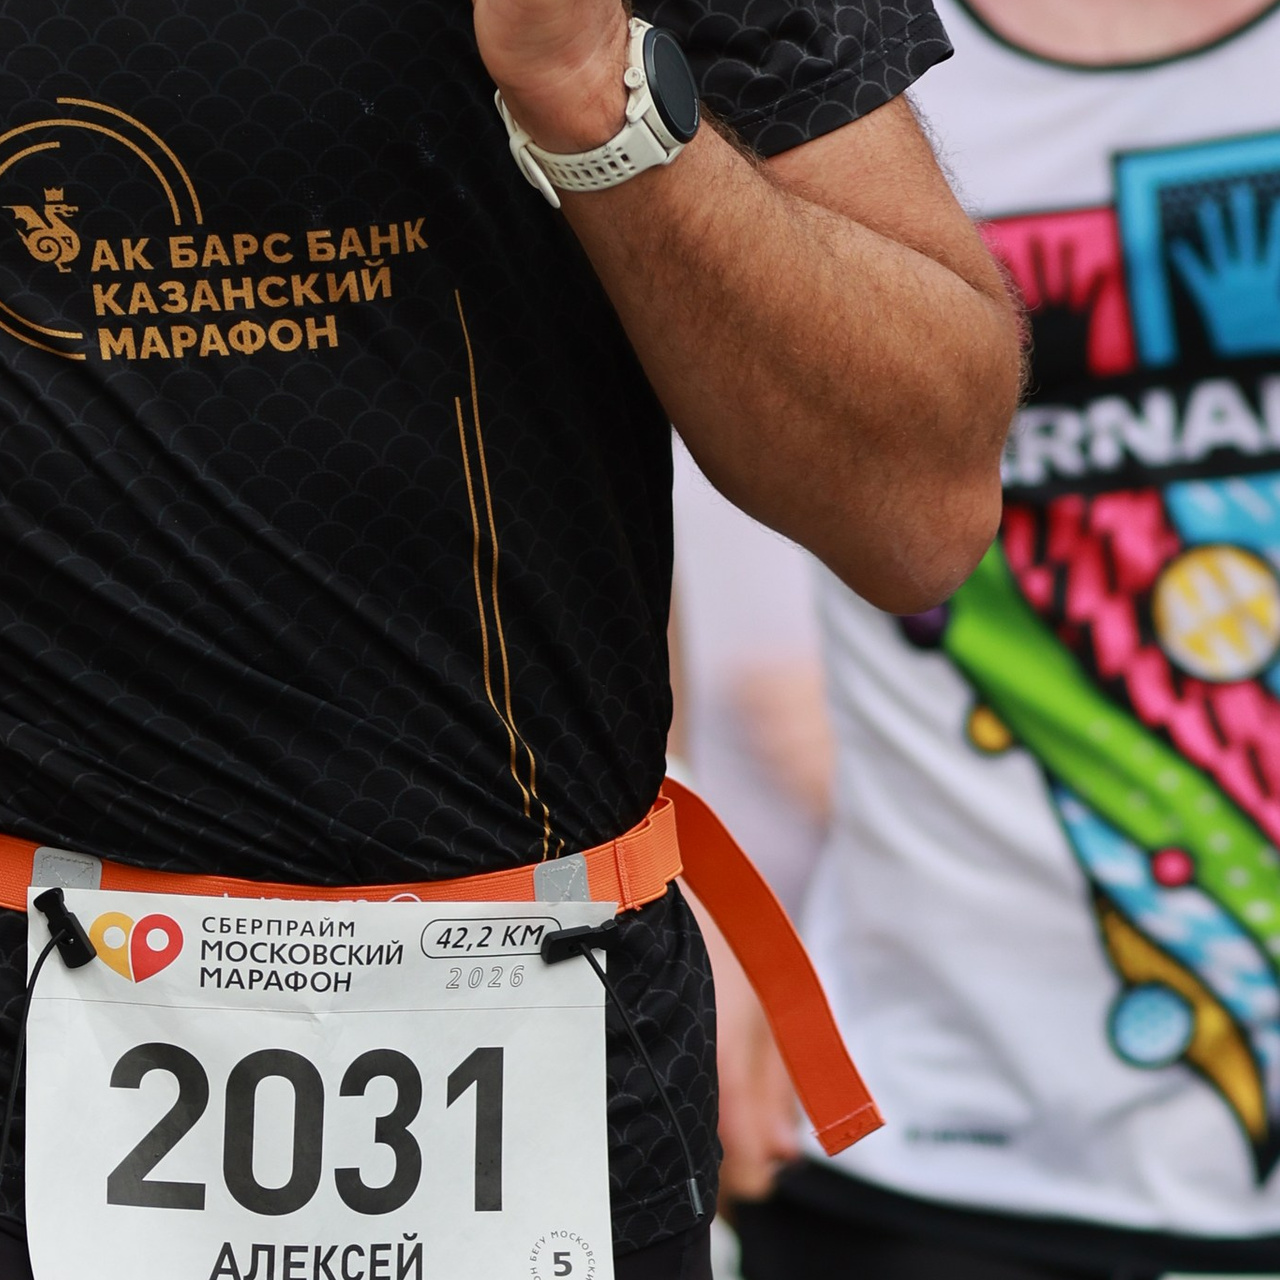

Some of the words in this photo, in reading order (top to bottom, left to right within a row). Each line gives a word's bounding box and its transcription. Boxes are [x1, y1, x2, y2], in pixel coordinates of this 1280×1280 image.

[90, 238, 151, 272] АК
[169, 231, 294, 268] БАРС
[307, 218, 429, 263] БАНК
[92, 258, 393, 316] КАЗАНСКИЙ
[98, 314, 339, 360] МАРАФОН
[1001, 375, 1280, 486] RNA
[201, 916, 356, 937] СБЕРПРАЙМ
[436, 926, 493, 951] 42,2
[200, 939, 404, 966] МОСКОВСКИЙ
[199, 968, 353, 993] МАРАФОН
[445, 965, 525, 989] 2026
[106, 1041, 505, 1217] 2031
[529, 1236, 546, 1262] БЕГУ
[553, 1251, 573, 1277] 5
